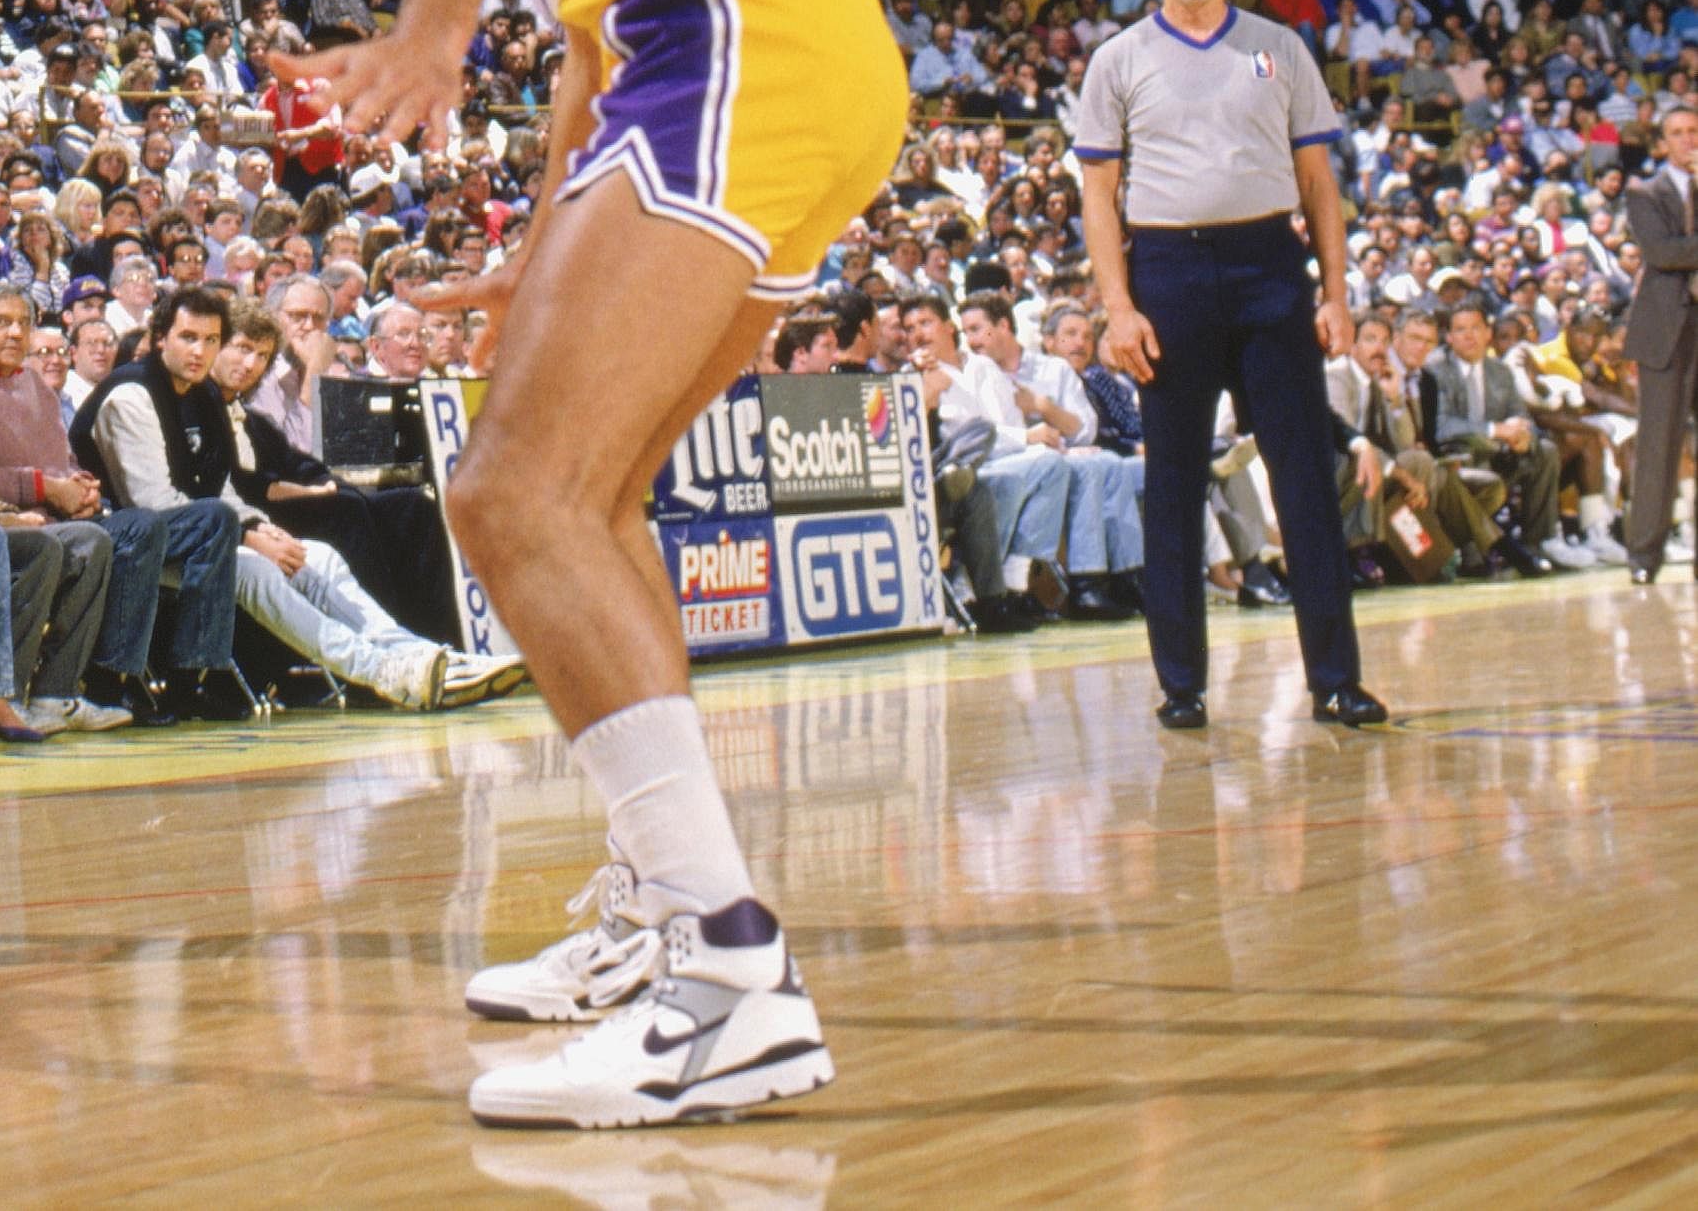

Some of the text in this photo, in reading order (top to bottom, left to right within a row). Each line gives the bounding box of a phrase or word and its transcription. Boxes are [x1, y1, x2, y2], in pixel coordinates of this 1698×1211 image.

[769, 416, 863, 479] Scotch
[724, 481, 769, 514] BEER
[900, 384, 937, 617] Reebok
[797, 531, 900, 621] GTE
[686, 603, 760, 634] TICKET
